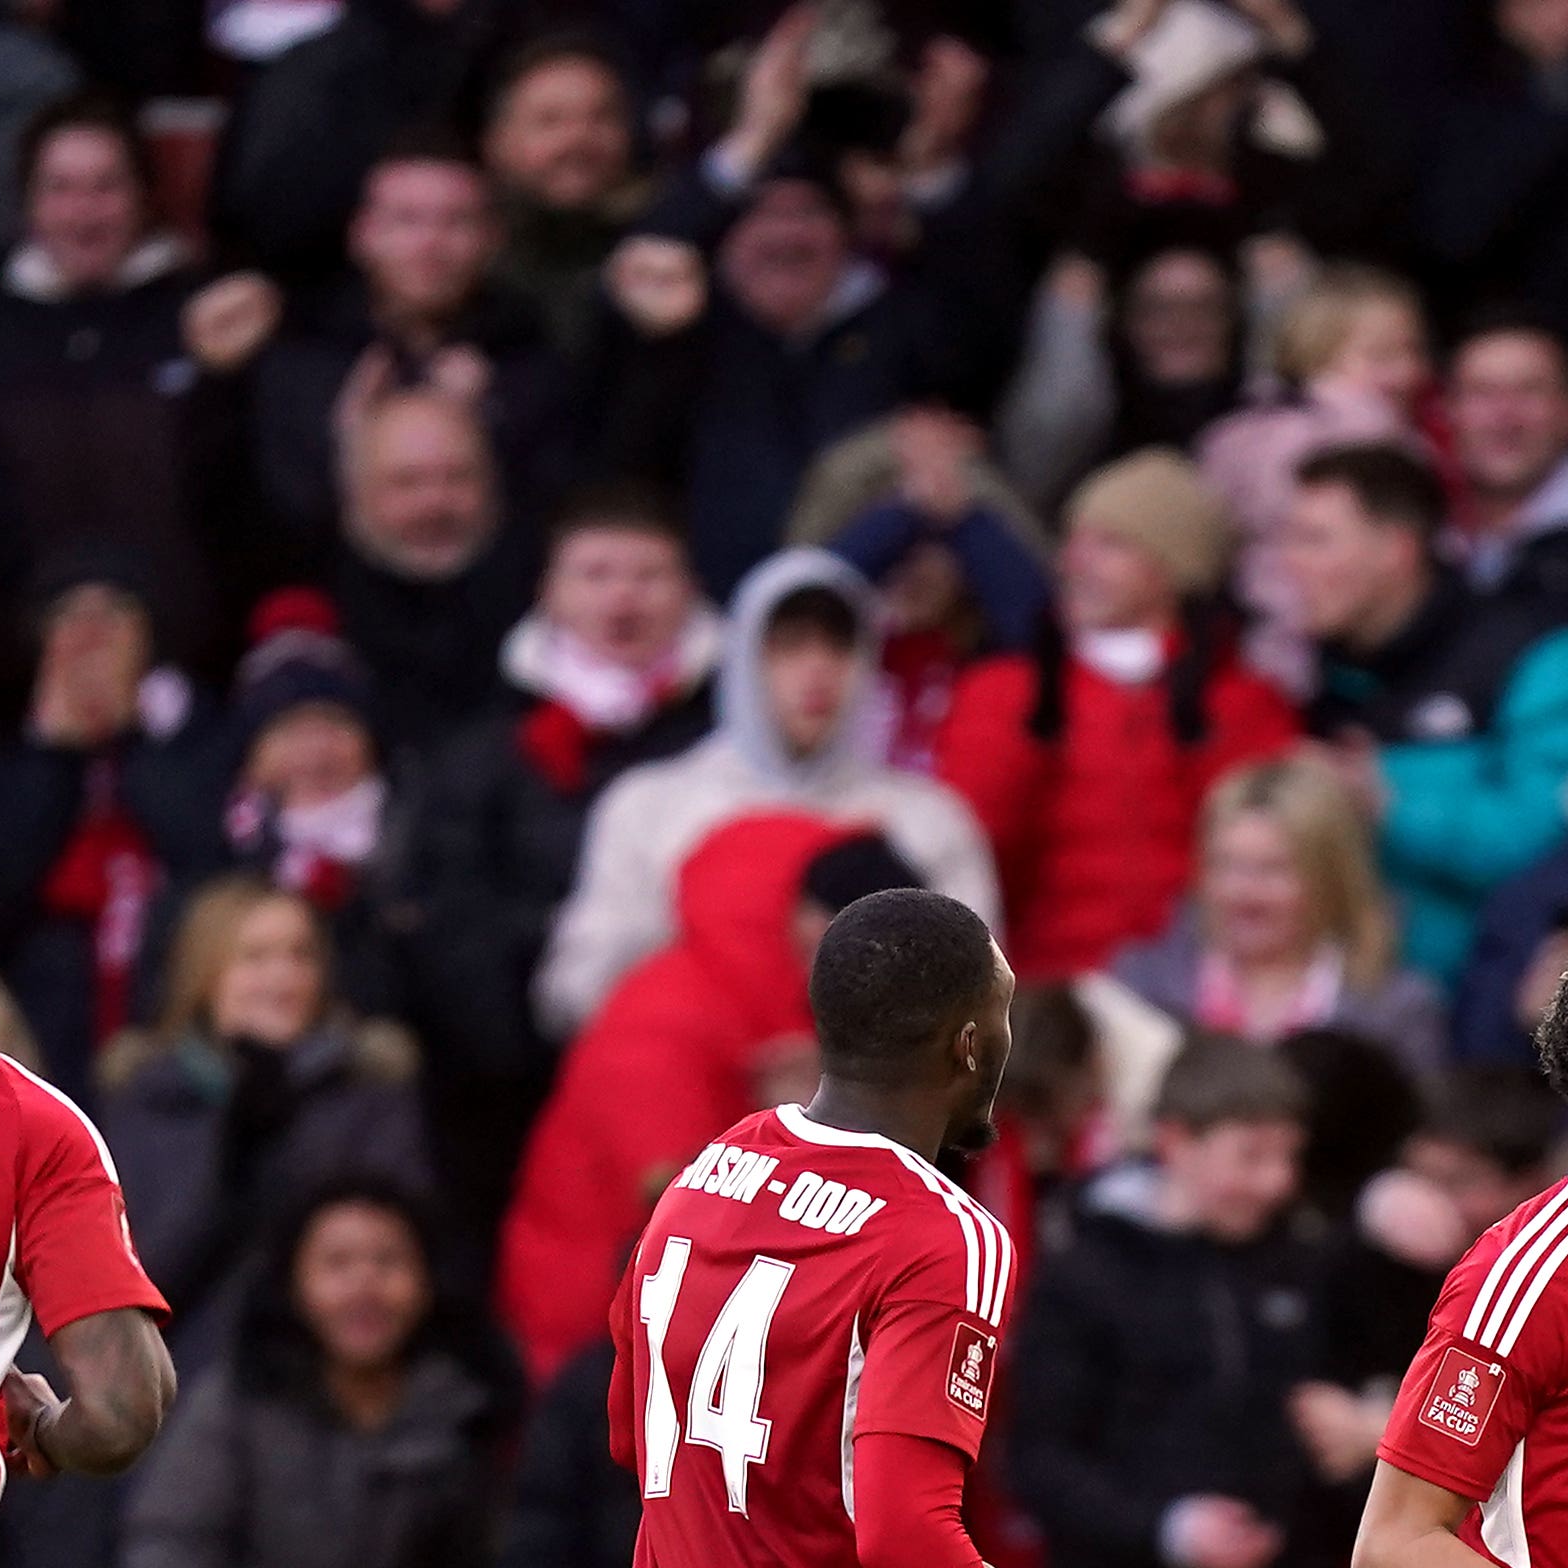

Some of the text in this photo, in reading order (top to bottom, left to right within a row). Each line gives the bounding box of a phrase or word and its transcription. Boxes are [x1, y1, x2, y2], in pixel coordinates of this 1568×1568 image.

[674, 1142, 888, 1236] DSON-ODOI
[639, 1235, 797, 1520] 14
[1427, 1406, 1477, 1435] FA CUP
[1432, 1394, 1480, 1425] Emirates
